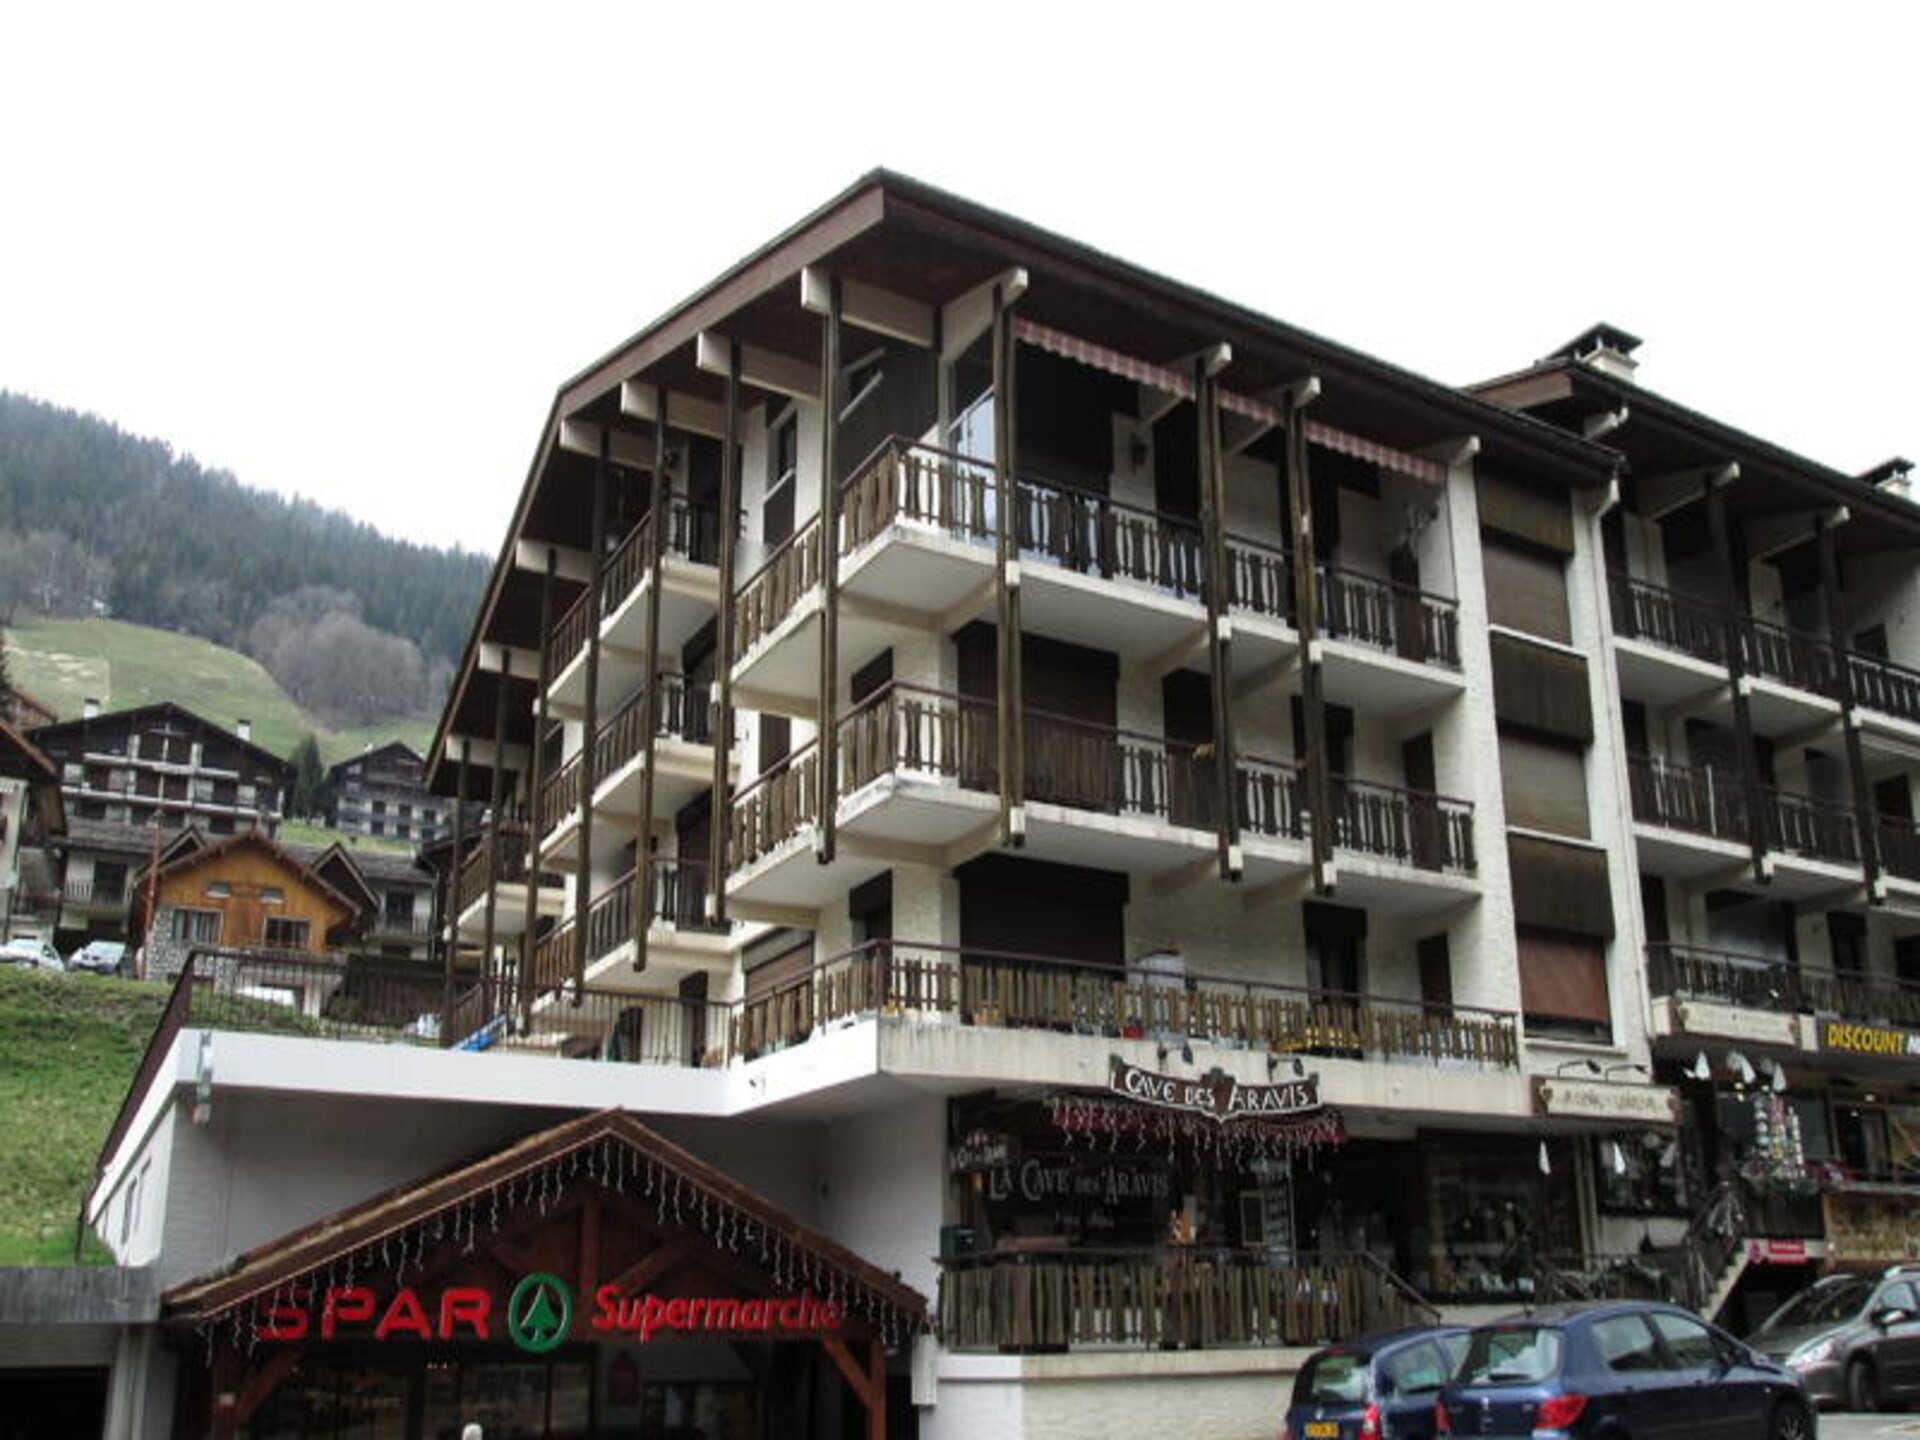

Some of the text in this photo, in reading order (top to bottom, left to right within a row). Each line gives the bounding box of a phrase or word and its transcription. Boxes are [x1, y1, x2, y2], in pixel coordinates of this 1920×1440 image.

[1828, 1024, 1904, 1054] DISCOUNT
[1125, 1068, 1176, 1102] CAVE
[1228, 1085, 1309, 1111] ARAVIS
[258, 1287, 492, 1340] SPAR
